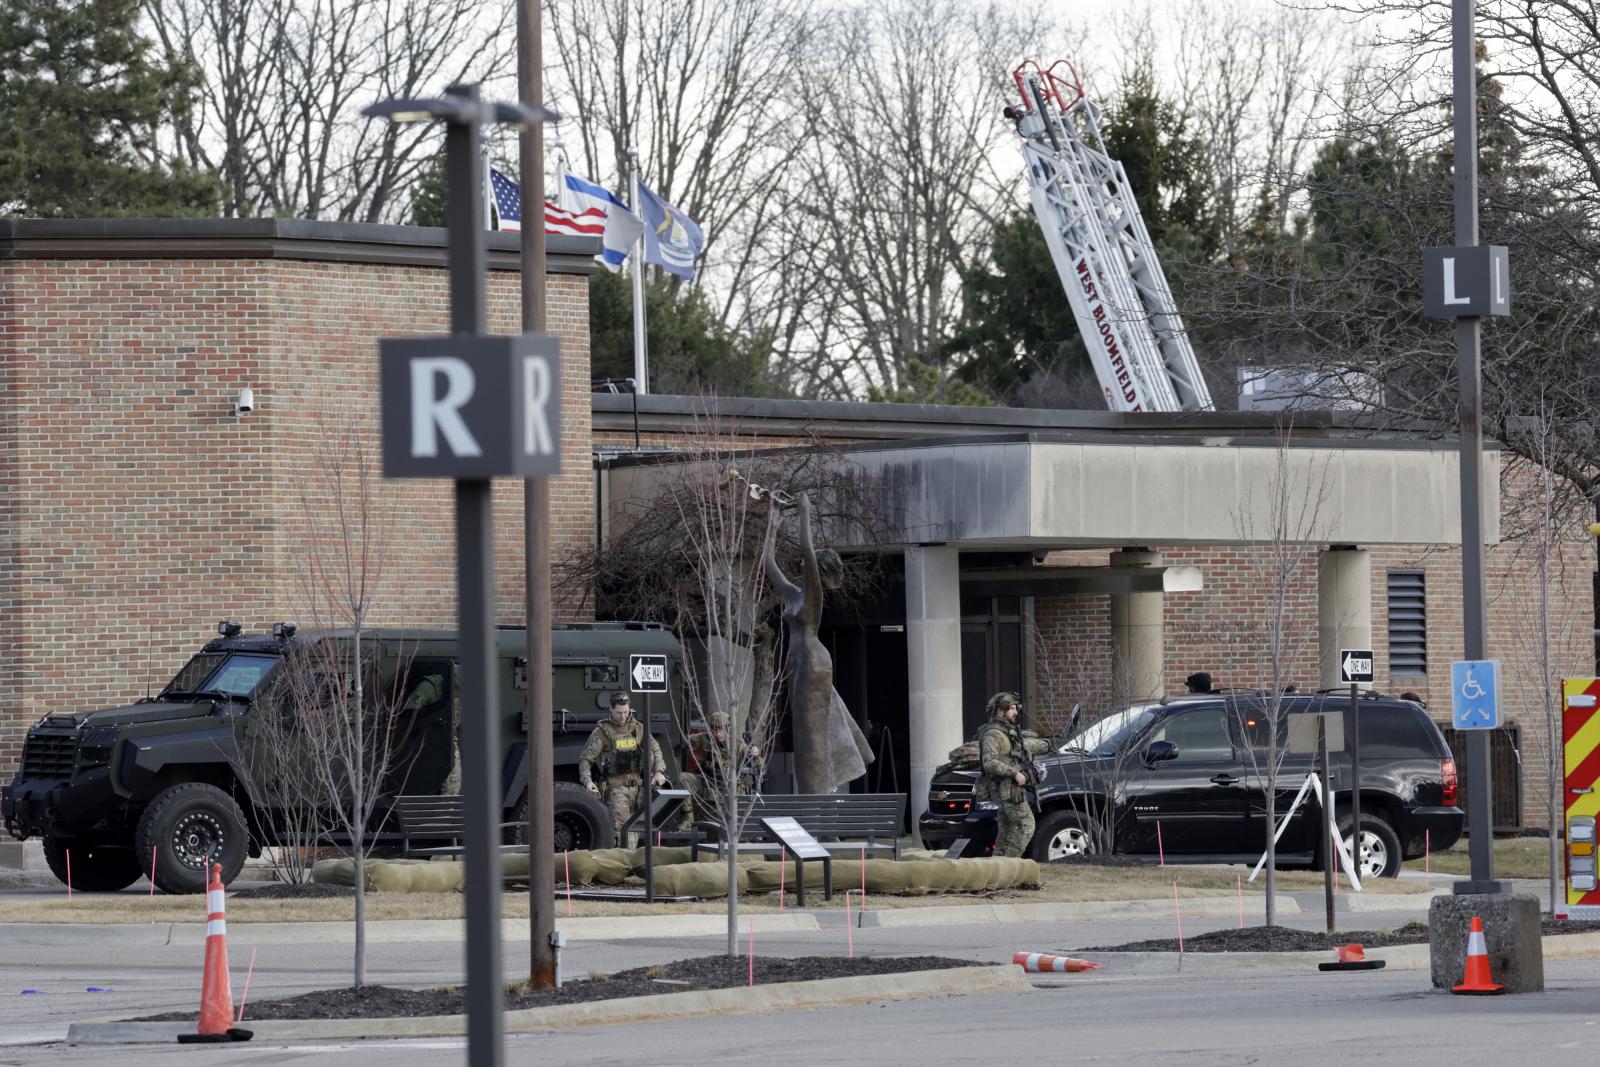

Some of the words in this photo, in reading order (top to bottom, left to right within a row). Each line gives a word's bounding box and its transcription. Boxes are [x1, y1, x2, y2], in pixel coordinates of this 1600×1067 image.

[1443, 257, 1470, 305] L
[1076, 257, 1100, 303] WEST
[1092, 303, 1137, 404] BLOOMFIELD
[409, 356, 483, 458] R
[522, 355, 554, 456] R
[641, 666, 651, 680] ONE
[652, 666, 663, 680] WAY
[1350, 660, 1360, 673] ONE
[1360, 660, 1370, 673] WAY
